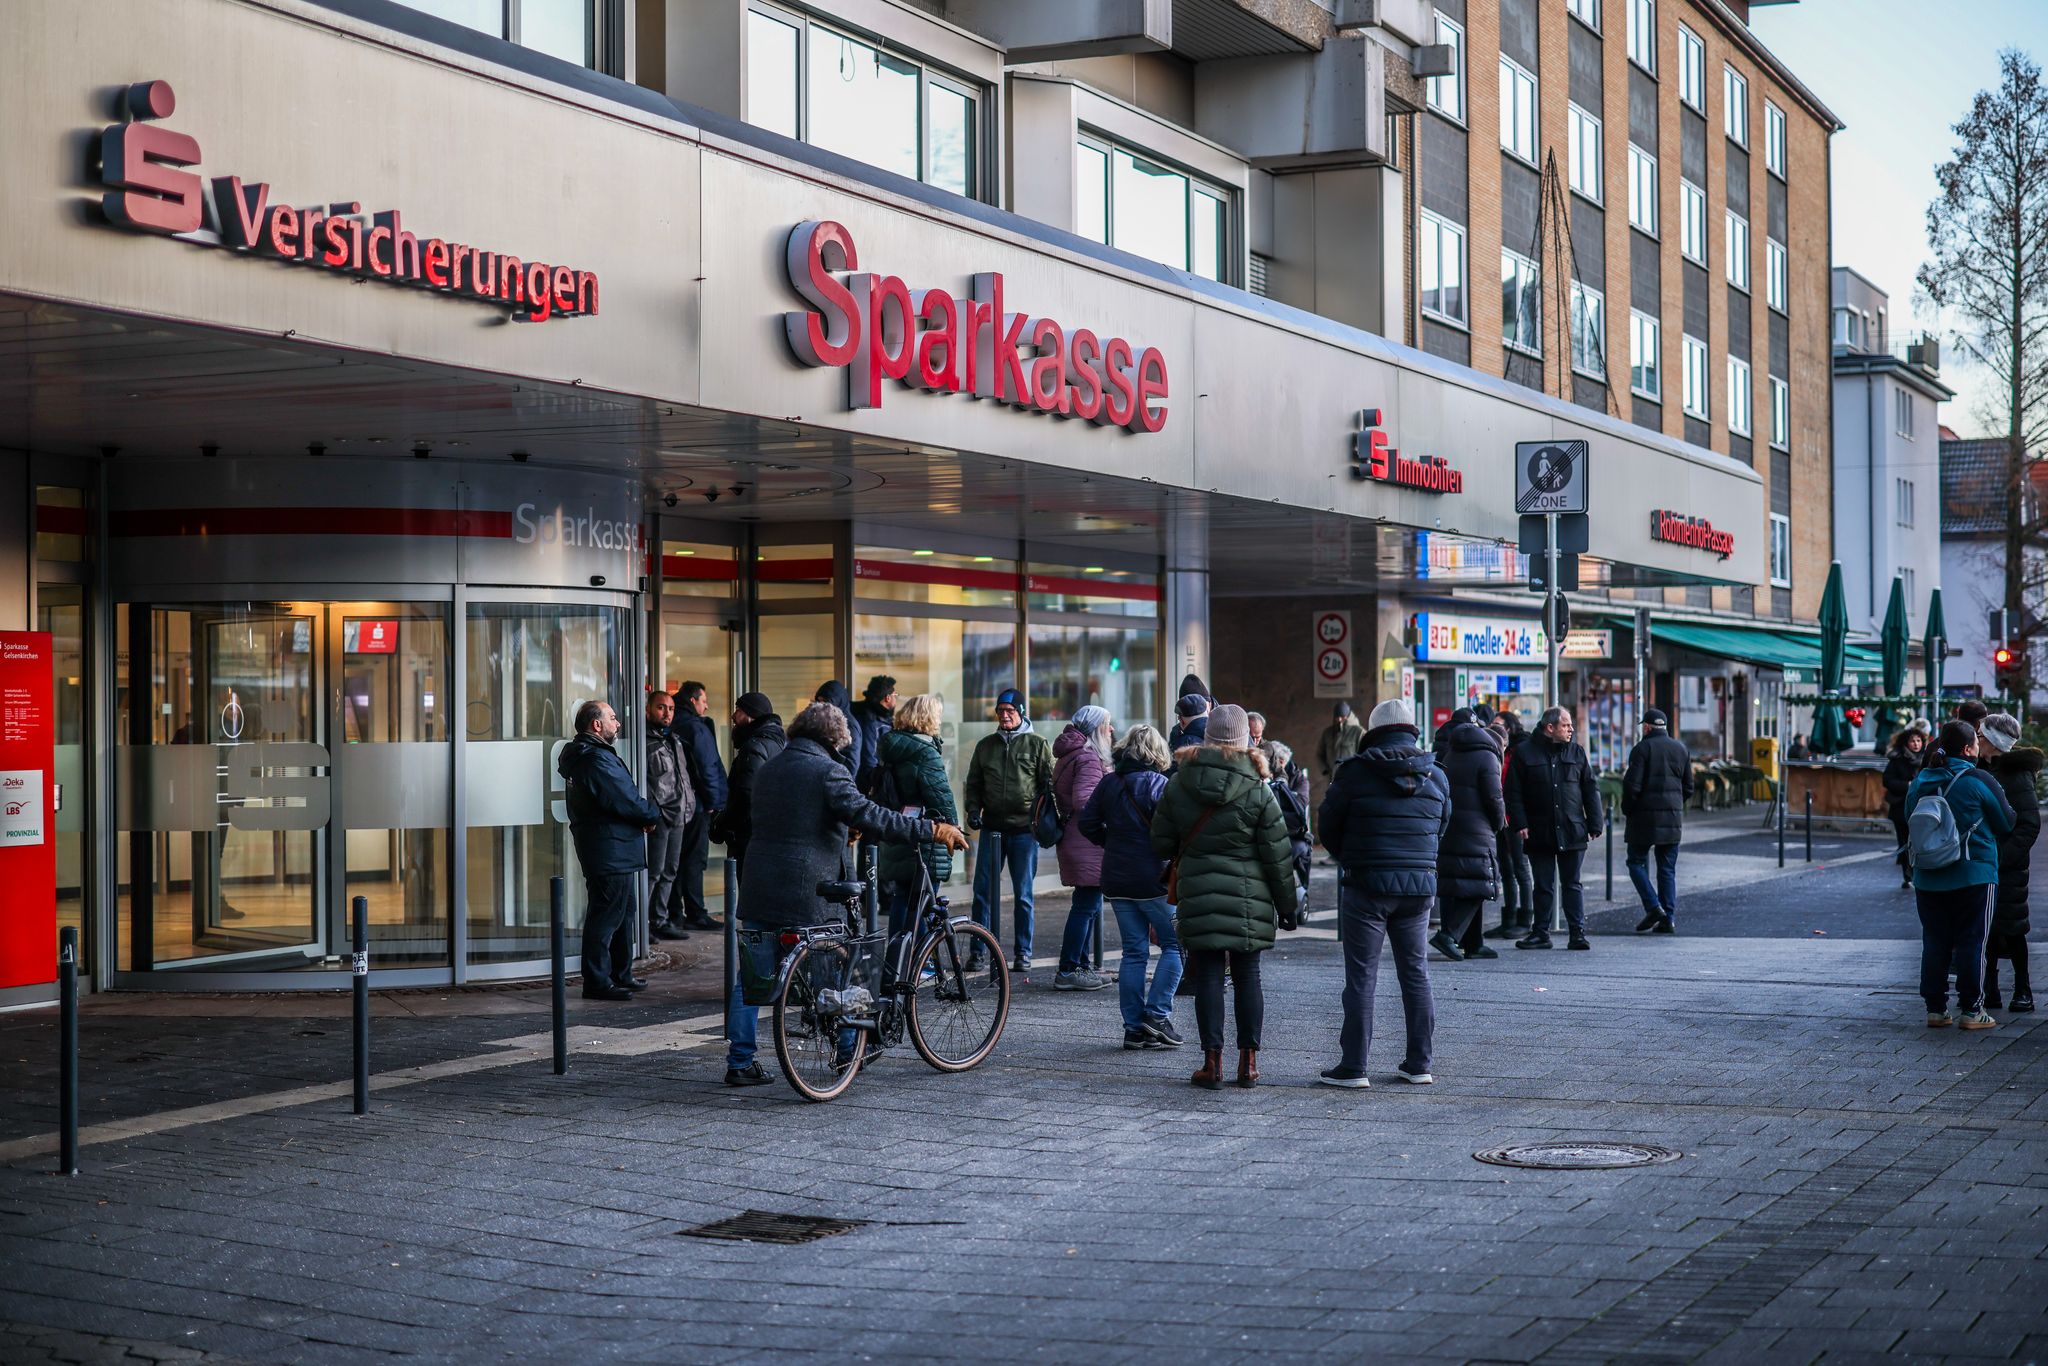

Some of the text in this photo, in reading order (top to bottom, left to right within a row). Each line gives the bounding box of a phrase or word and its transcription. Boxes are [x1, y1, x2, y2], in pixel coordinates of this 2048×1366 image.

[212, 175, 599, 323] Versicherungen
[785, 220, 1169, 433] Sparkasse
[1393, 448, 1463, 494] Immobilien
[1533, 495, 1567, 509] ZONE
[516, 502, 639, 555] Sparkasse
[1463, 625, 1531, 656] moeller-24.de
[4, 778, 24, 786] Deka
[6, 807, 20, 815] LBS
[6, 830, 39, 838] PROVINZIAL
